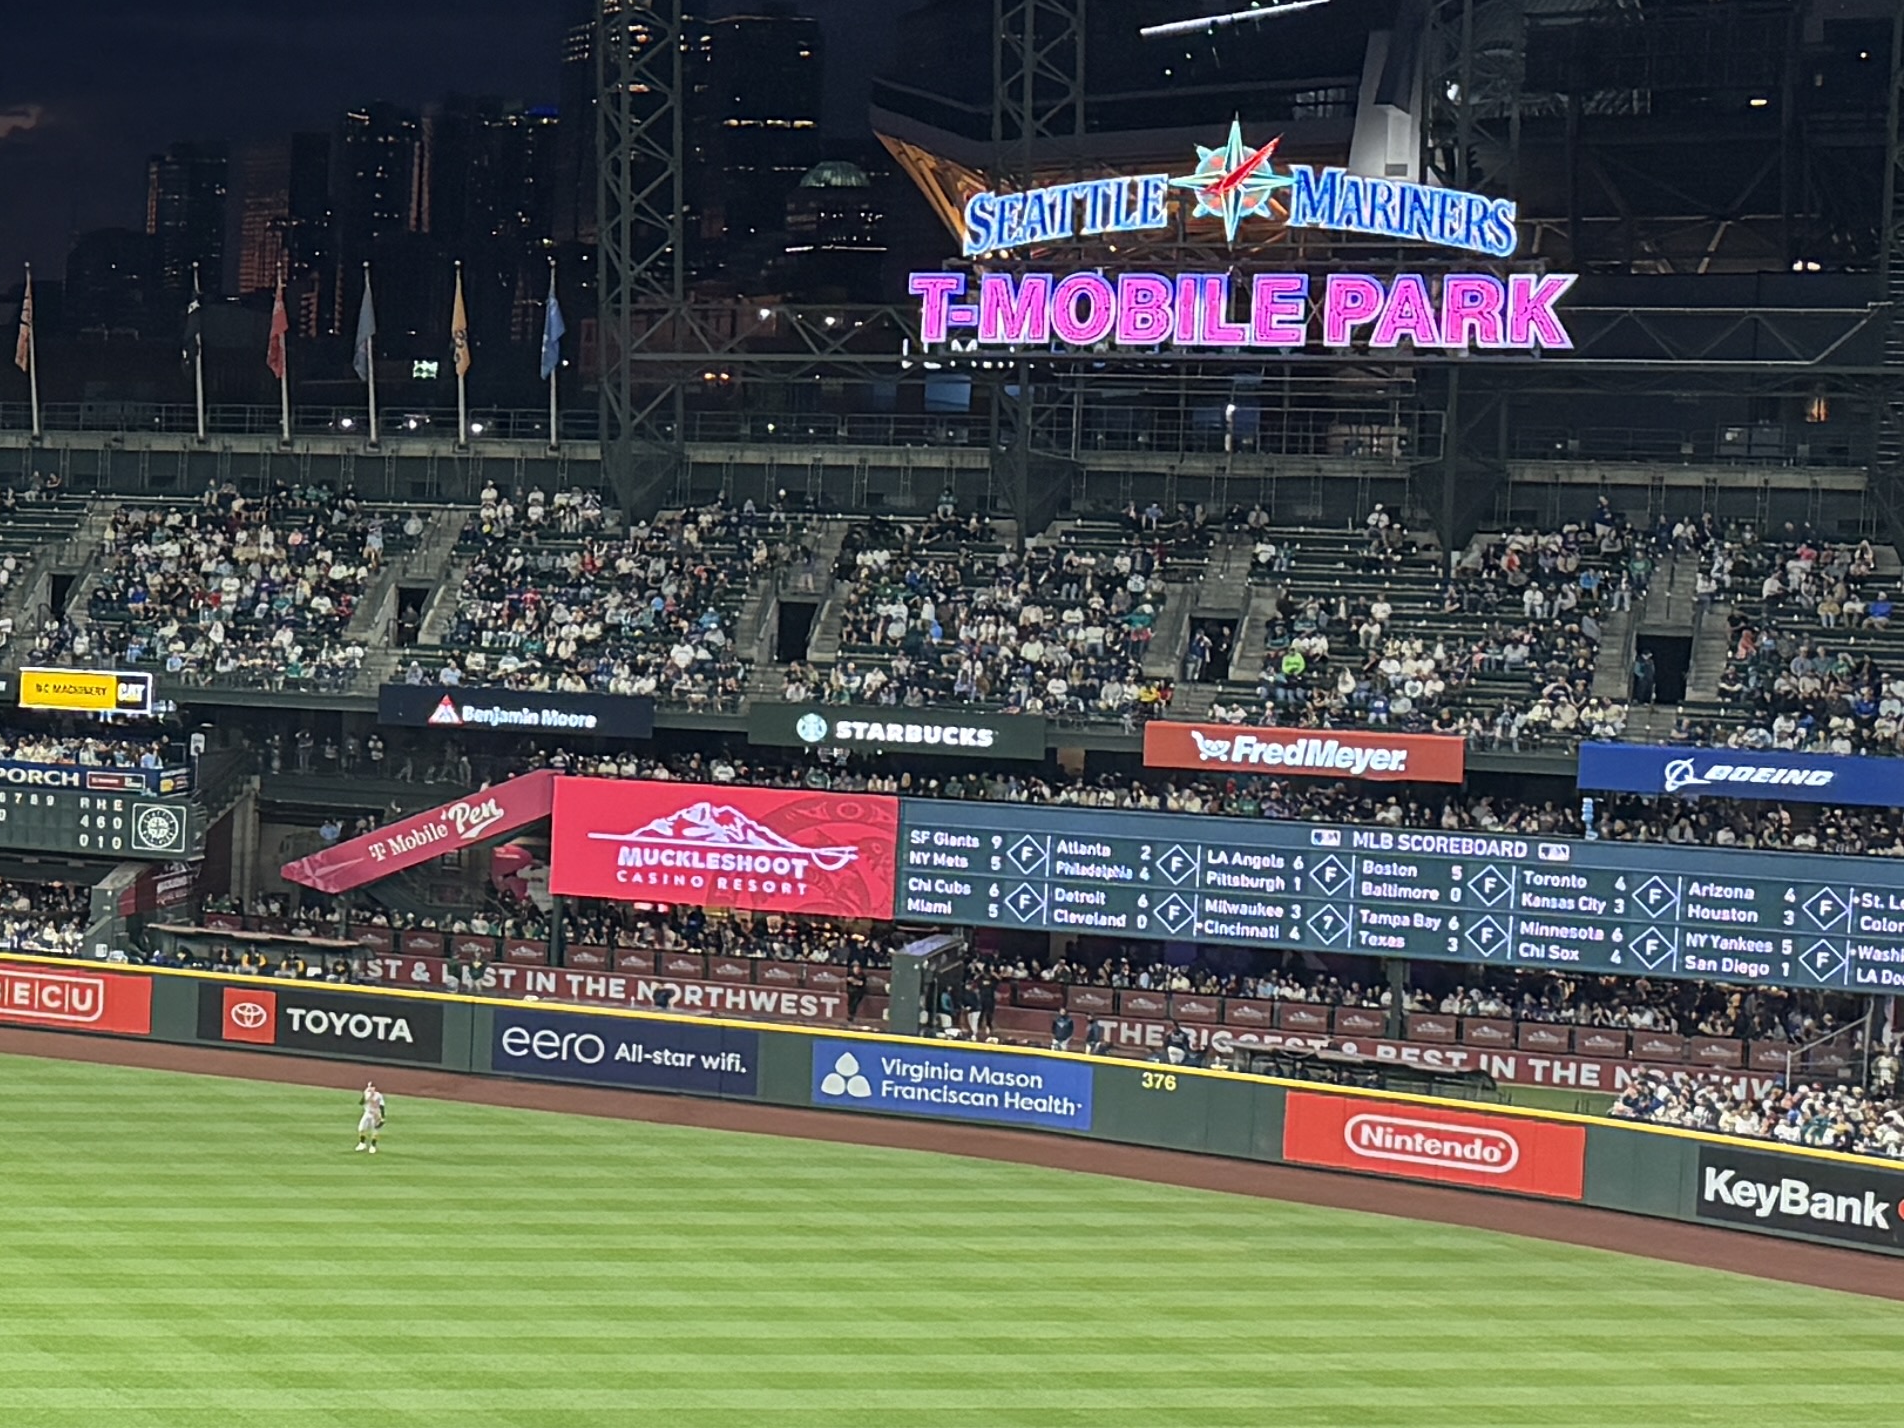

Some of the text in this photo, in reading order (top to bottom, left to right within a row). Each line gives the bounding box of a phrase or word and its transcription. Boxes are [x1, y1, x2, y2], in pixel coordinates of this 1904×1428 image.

[963, 164, 1517, 258] SEATTLE MARINERS
[908, 272, 1578, 349] T-MOBILE PARK
[462, 705, 597, 729] Benjamin Moore
[835, 720, 993, 748] STARBUCKS
[1704, 764, 1836, 788] BOEING
[388, 821, 449, 859] Mobile
[910, 830, 980, 849] SF Giants
[1057, 840, 1111, 858] Atlanta
[1353, 831, 1528, 859] MLB SCOREBOARD
[618, 846, 810, 880] MUCKLESHOOT
[910, 850, 969, 868] NY Mets
[1208, 848, 1285, 871] LA Angels
[1363, 859, 1418, 878] Boston
[1056, 860, 1134, 881] Philadelphia
[1207, 870, 1285, 892] Pittsburgh
[1524, 870, 1588, 890] Toronto
[616, 870, 808, 896] CASINO RESORT
[908, 877, 972, 896] Chi Cubs
[1361, 881, 1440, 901] Baltimore
[1689, 883, 1755, 902] Arizona
[908, 898, 952, 914] Miami
[1055, 887, 1106, 906] Detroit
[1521, 892, 1607, 917] Kansas City
[1861, 892, 1885, 909] St.
[1053, 909, 1127, 929] Cleveland
[1205, 899, 1284, 919] Milwaukee
[1688, 904, 1759, 925] Houston
[1203, 918, 1280, 940] Cincinnati
[1360, 908, 1441, 933] Tampa Bay
[1359, 931, 1406, 949] Texas
[1520, 921, 1605, 943] Minnesota
[1686, 932, 1774, 954] NY Yankees
[1518, 943, 1580, 963] Chi Sox
[1685, 954, 1770, 978] San Diego
[1856, 967, 1878, 984] LA
[525, 971, 556, 993] IN
[572, 973, 626, 1000] THE
[287, 1007, 414, 1043] TOYOTA
[502, 1026, 605, 1064] eero
[1097, 1020, 1164, 1047] THE
[1480, 1053, 1516, 1080] IN
[1527, 1058, 1601, 1087] THE
[614, 1041, 747, 1074] All-star wifi.
[881, 1057, 1044, 1090] Virginia Mason
[1142, 1071, 1177, 1092] 376
[881, 1079, 1000, 1109] Franciscan
[1360, 1125, 1505, 1165] Nintendo
[1704, 1166, 1891, 1231] KeyBank
